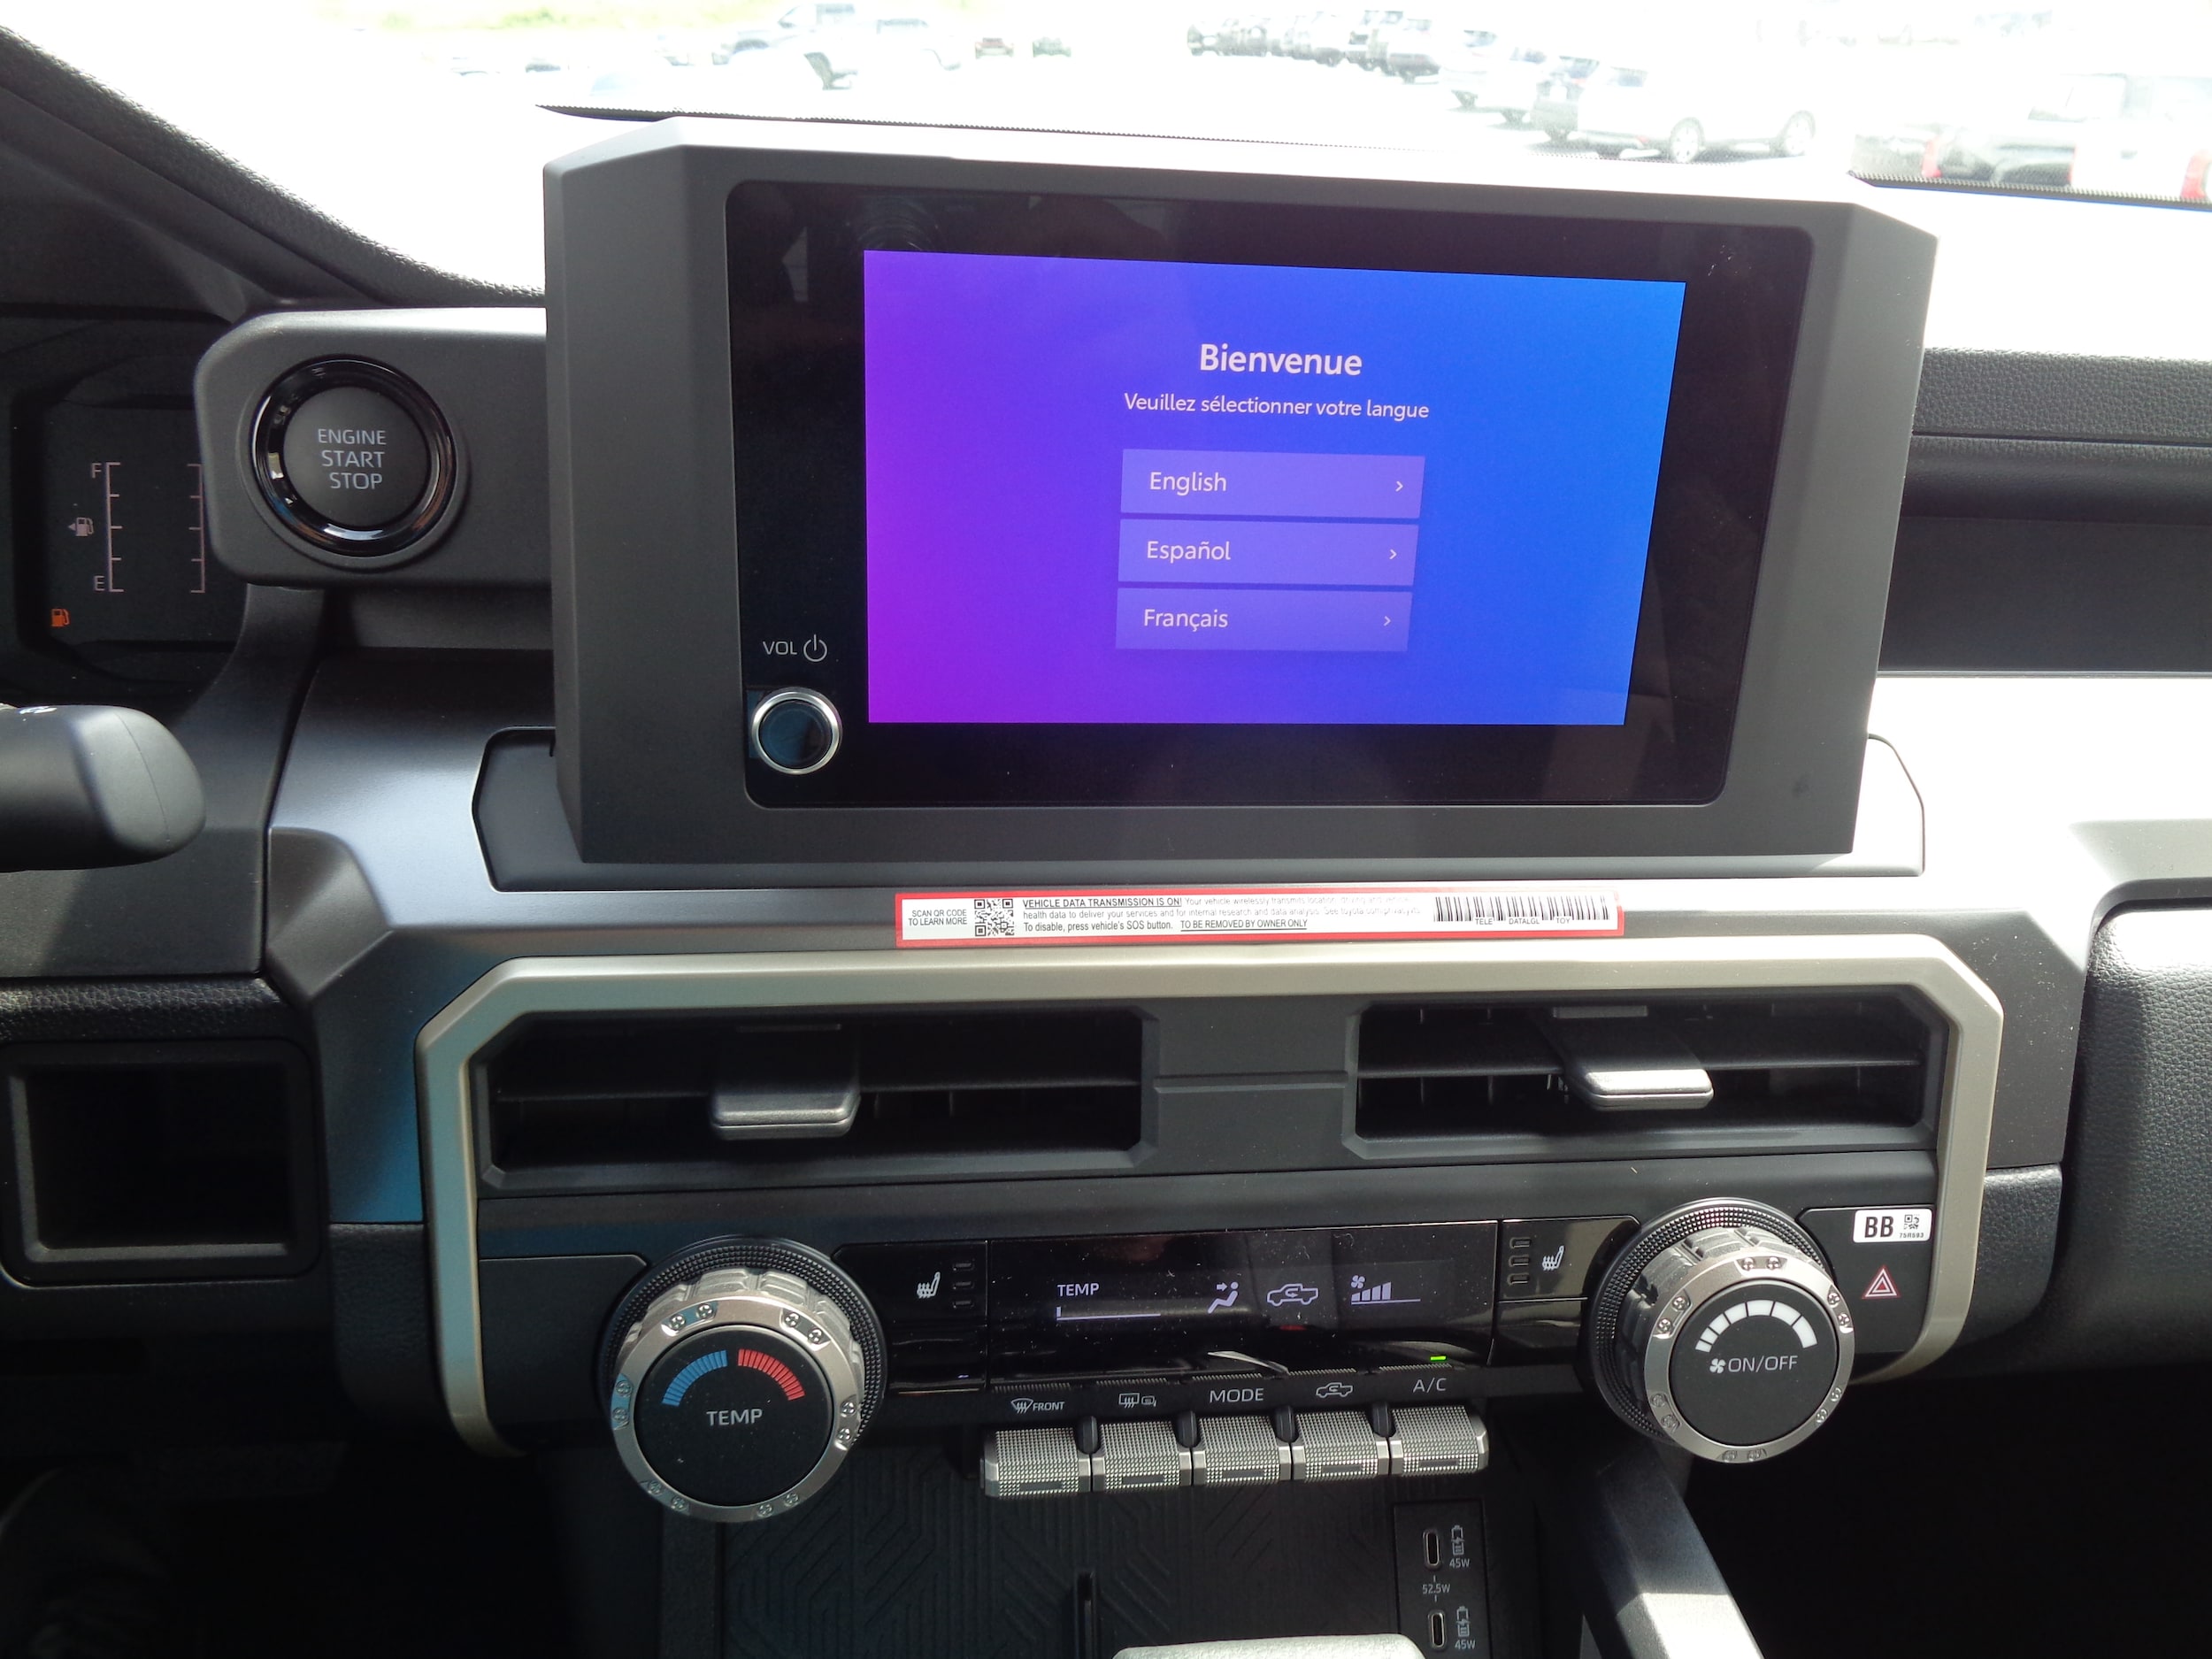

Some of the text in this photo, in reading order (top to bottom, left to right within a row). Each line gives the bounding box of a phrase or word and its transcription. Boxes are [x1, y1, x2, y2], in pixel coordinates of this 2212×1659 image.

[1199, 342, 1363, 376] Bienvenue
[1124, 392, 1429, 421] Veuillez sélectionner votre langue
[317, 427, 388, 445] ENGINE
[321, 449, 386, 468] START
[91, 462, 102, 479] F
[328, 472, 383, 490] STOP
[1149, 471, 1227, 497] English
[1146, 540, 1232, 565] Español
[94, 574, 105, 592] E
[1143, 608, 1229, 633] Français
[762, 641, 798, 656] VOL
[1023, 898, 1060, 908] VEHICLE
[1063, 898, 1088, 908] DATA
[1088, 897, 1155, 908] TRANSMISSION
[1156, 897, 1164, 907] IS
[1166, 897, 1182, 907] ON!
[1184, 897, 1202, 906] Your
[1204, 896, 1231, 906] vehicle
[1233, 896, 1270, 907] wirelessly
[908, 918, 919, 926] TO
[945, 917, 968, 926] MORE
[1023, 910, 1048, 919] health
[1048, 910, 1067, 919] data
[1079, 910, 1105, 918] deliver
[1107, 910, 1125, 920] your
[1125, 909, 1158, 918] services
[1160, 909, 1174, 918] and
[1176, 908, 1187, 917] for
[1024, 922, 1033, 932] To
[1034, 922, 1065, 933] disable,
[1067, 923, 1089, 933] press
[1091, 920, 1125, 930] vehicle's
[1126, 920, 1144, 930] SOS
[1147, 920, 1174, 930] button.
[1180, 920, 1191, 929] TO
[1204, 919, 1244, 928] REMOVED
[1287, 918, 1308, 927] ONLY
[1864, 1216, 1894, 1239] BB
[1057, 1282, 1100, 1297] TEMP
[1728, 1354, 1799, 1373] ON/OFF
[1412, 1377, 1448, 1394] A/C
[1209, 1386, 1265, 1404] MODE
[1032, 1400, 1065, 1413] FRONT
[706, 1408, 763, 1427] TEMP
[1448, 1558, 1471, 1568] 45W
[1422, 1583, 1451, 1594] 52.5W
[1454, 1640, 1477, 1649] 45W
